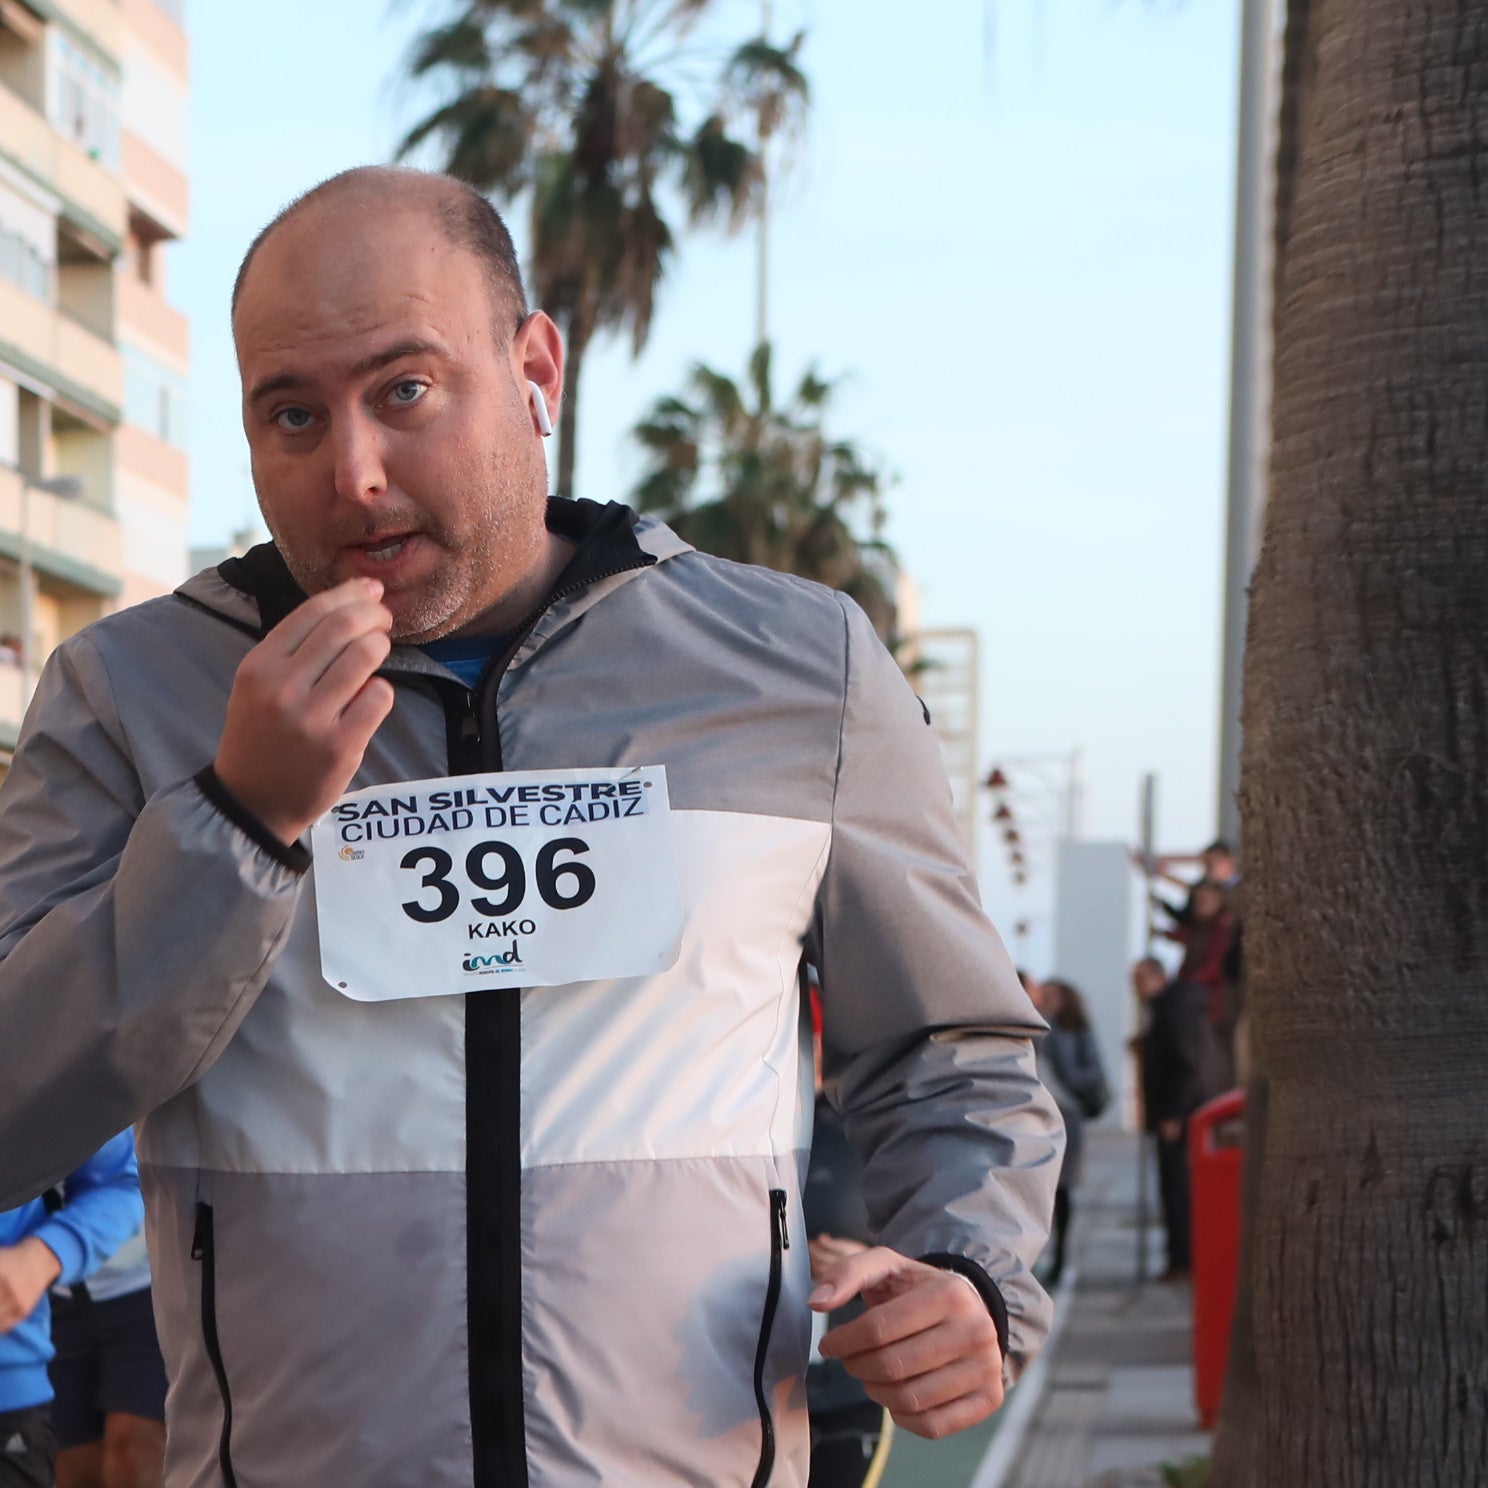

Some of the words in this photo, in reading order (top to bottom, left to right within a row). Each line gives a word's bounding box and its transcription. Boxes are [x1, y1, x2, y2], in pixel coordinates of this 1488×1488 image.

[338, 796, 417, 822] SAN
[429, 780, 641, 811] SILVESTRE
[341, 808, 473, 842] CIUDAD
[486, 805, 525, 828] DE
[399, 837, 596, 923] 396
[467, 919, 537, 939] KAKO
[462, 940, 523, 971] imd
